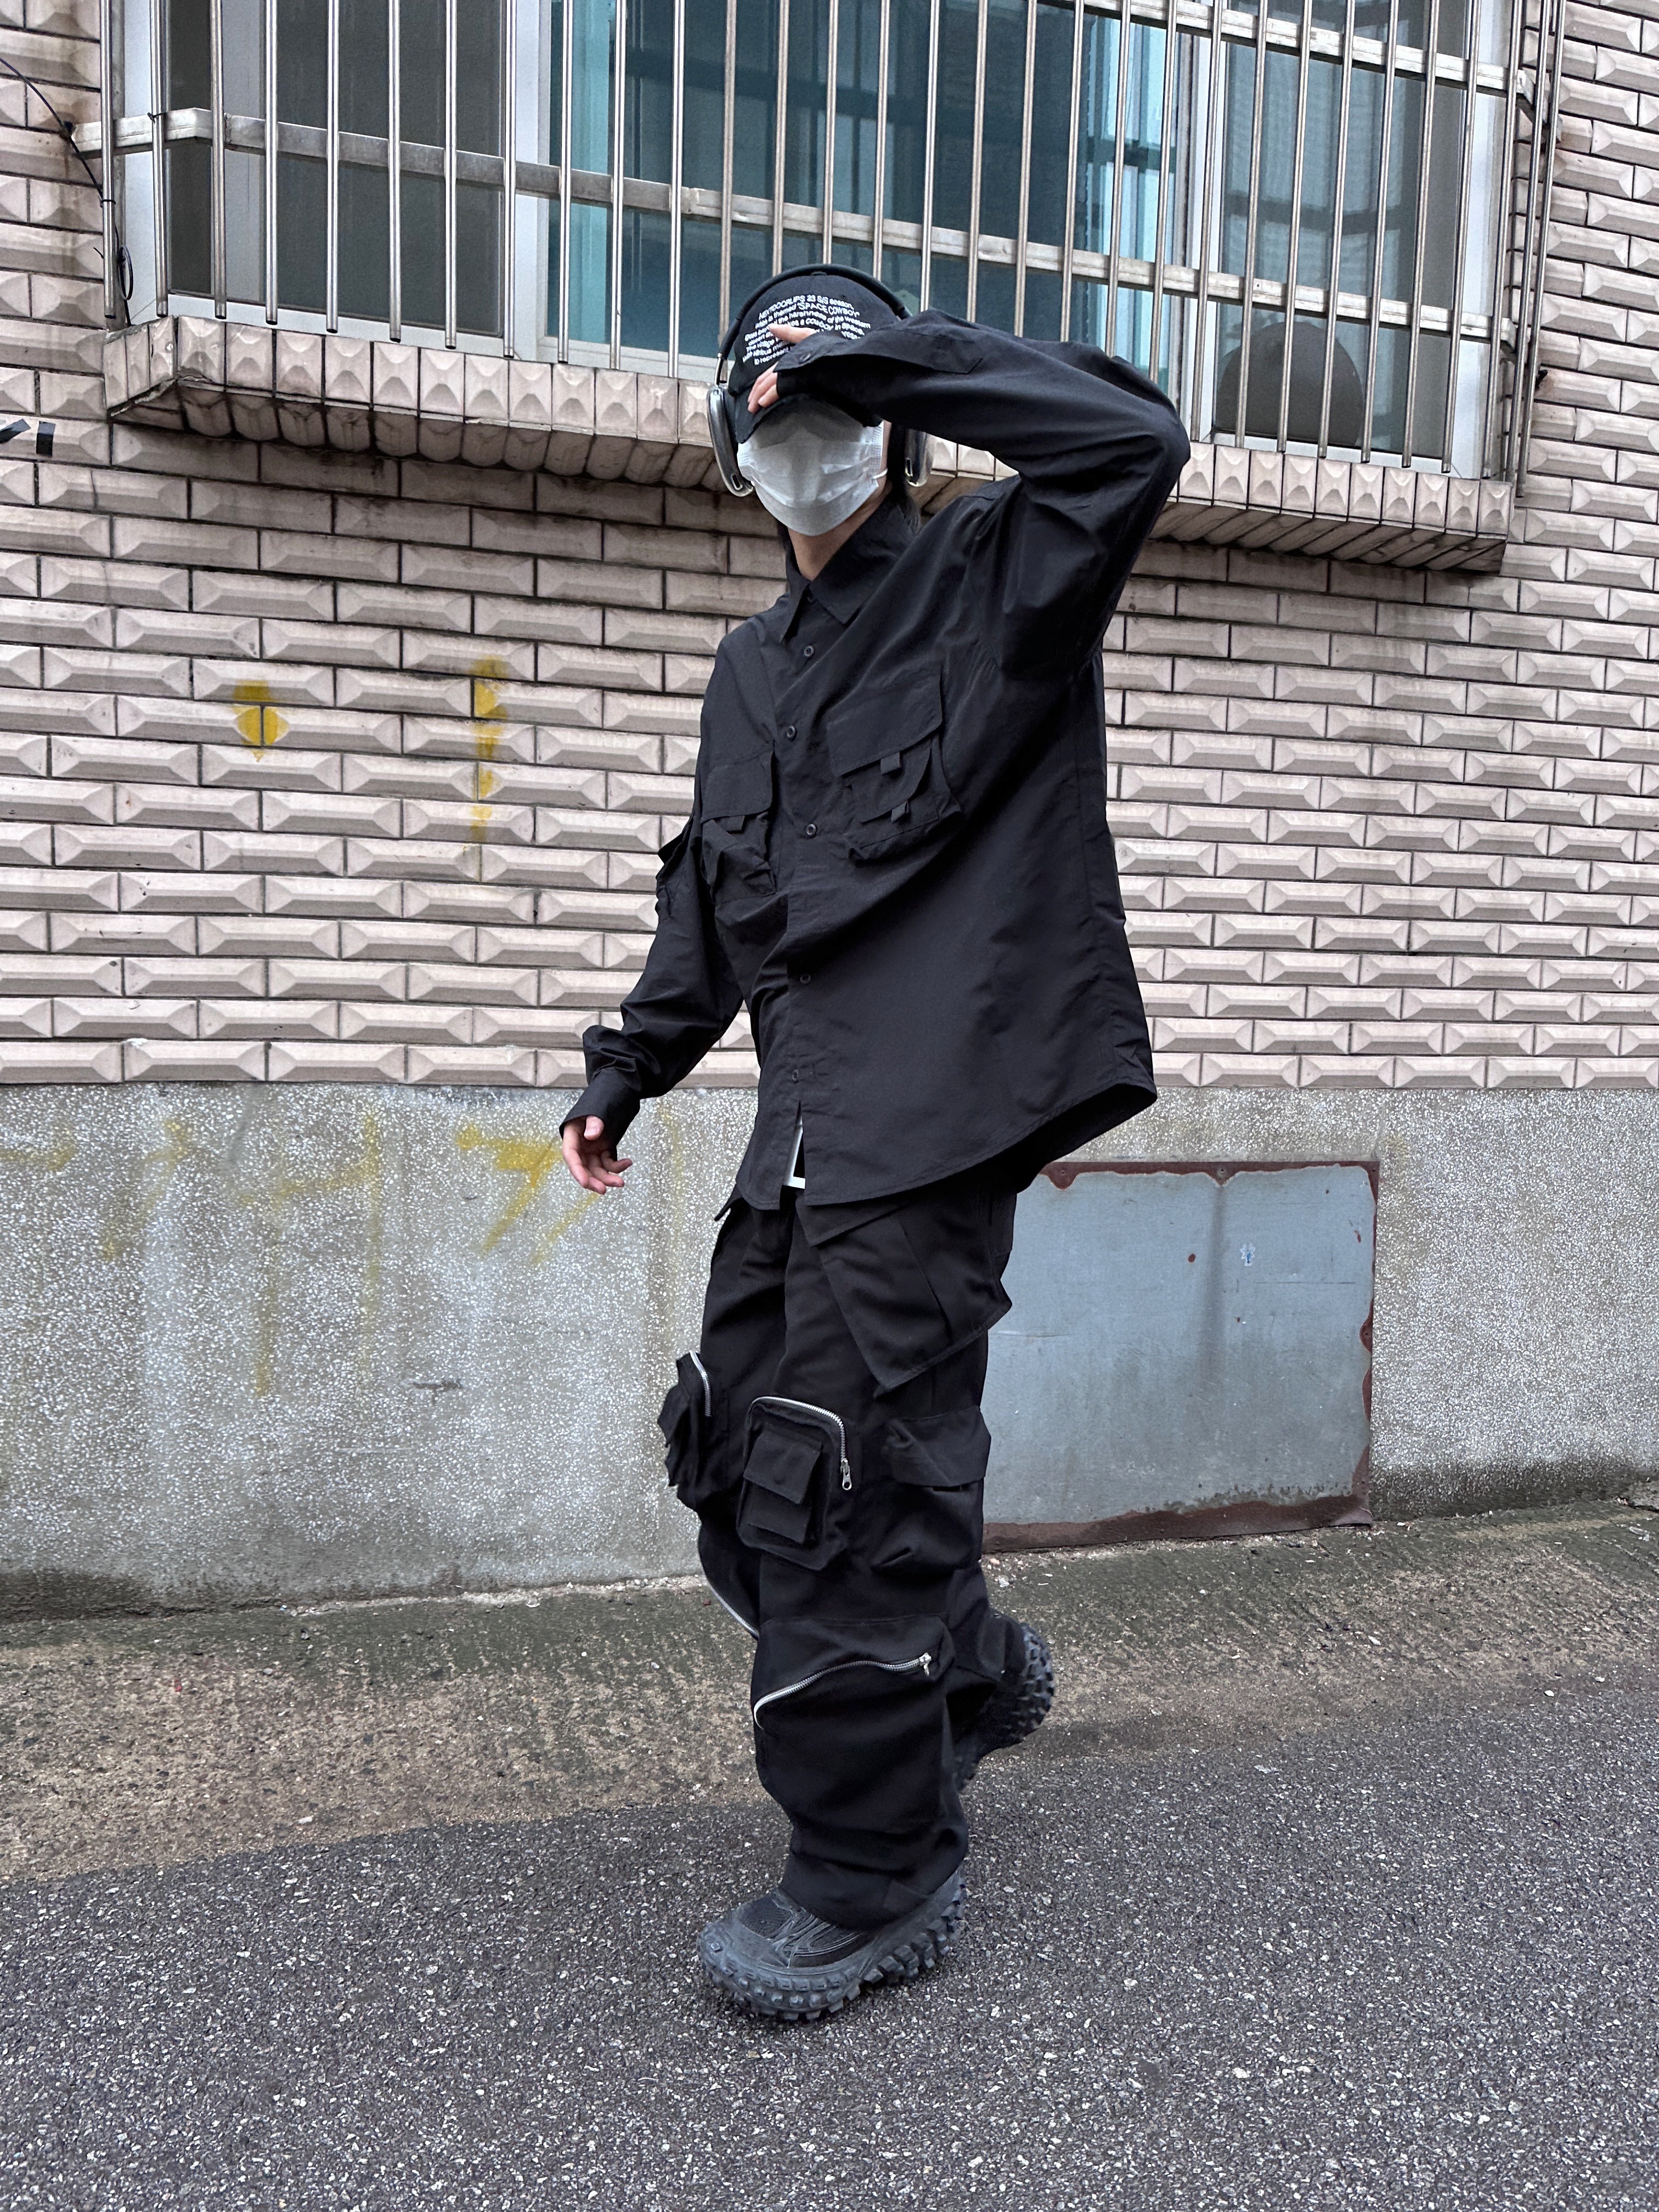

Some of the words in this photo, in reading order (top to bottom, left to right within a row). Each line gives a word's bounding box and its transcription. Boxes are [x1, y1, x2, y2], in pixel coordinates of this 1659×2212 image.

[817, 295, 828, 304] S/S
[805, 318, 834, 331] cowboy
[844, 316, 871, 329] western
